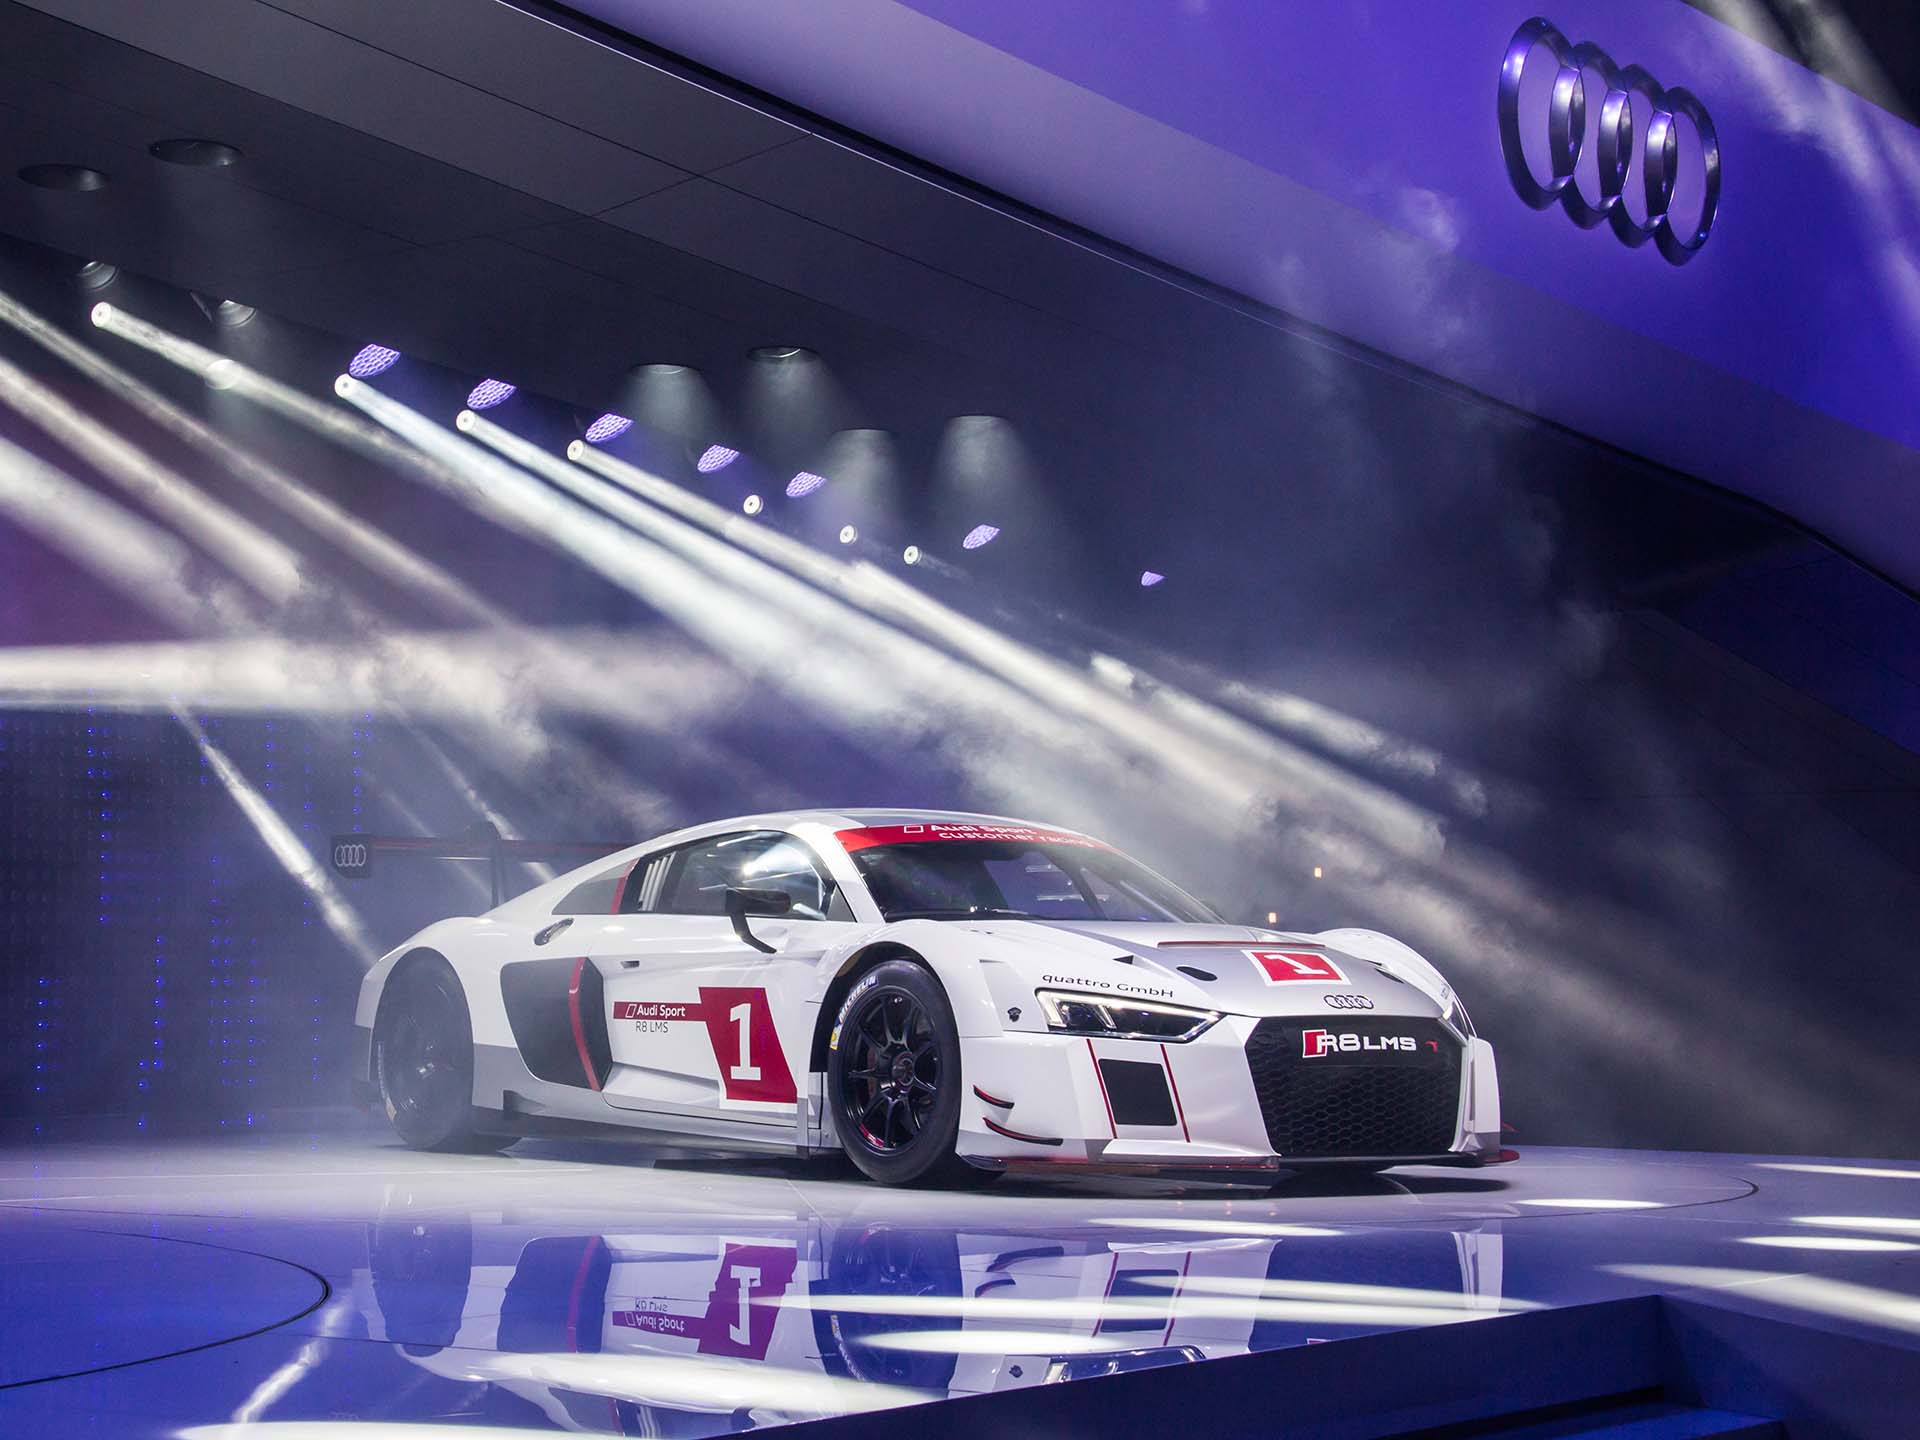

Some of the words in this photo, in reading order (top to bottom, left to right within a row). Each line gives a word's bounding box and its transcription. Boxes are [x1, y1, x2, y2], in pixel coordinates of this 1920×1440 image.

[939, 832, 1034, 841] customer
[979, 825, 1037, 835] Sport
[1264, 954, 1329, 975] 1
[1042, 974, 1111, 989] quattro
[1117, 983, 1174, 998] GmbH
[838, 975, 876, 1023] MICHELIN
[636, 1004, 658, 1016] Audi
[659, 1004, 686, 1019] Sport
[636, 1021, 648, 1033] R8
[650, 1021, 669, 1034] LMS
[729, 1003, 762, 1081] 1
[1316, 1033, 1361, 1054] R8
[1363, 1035, 1417, 1051] LMS
